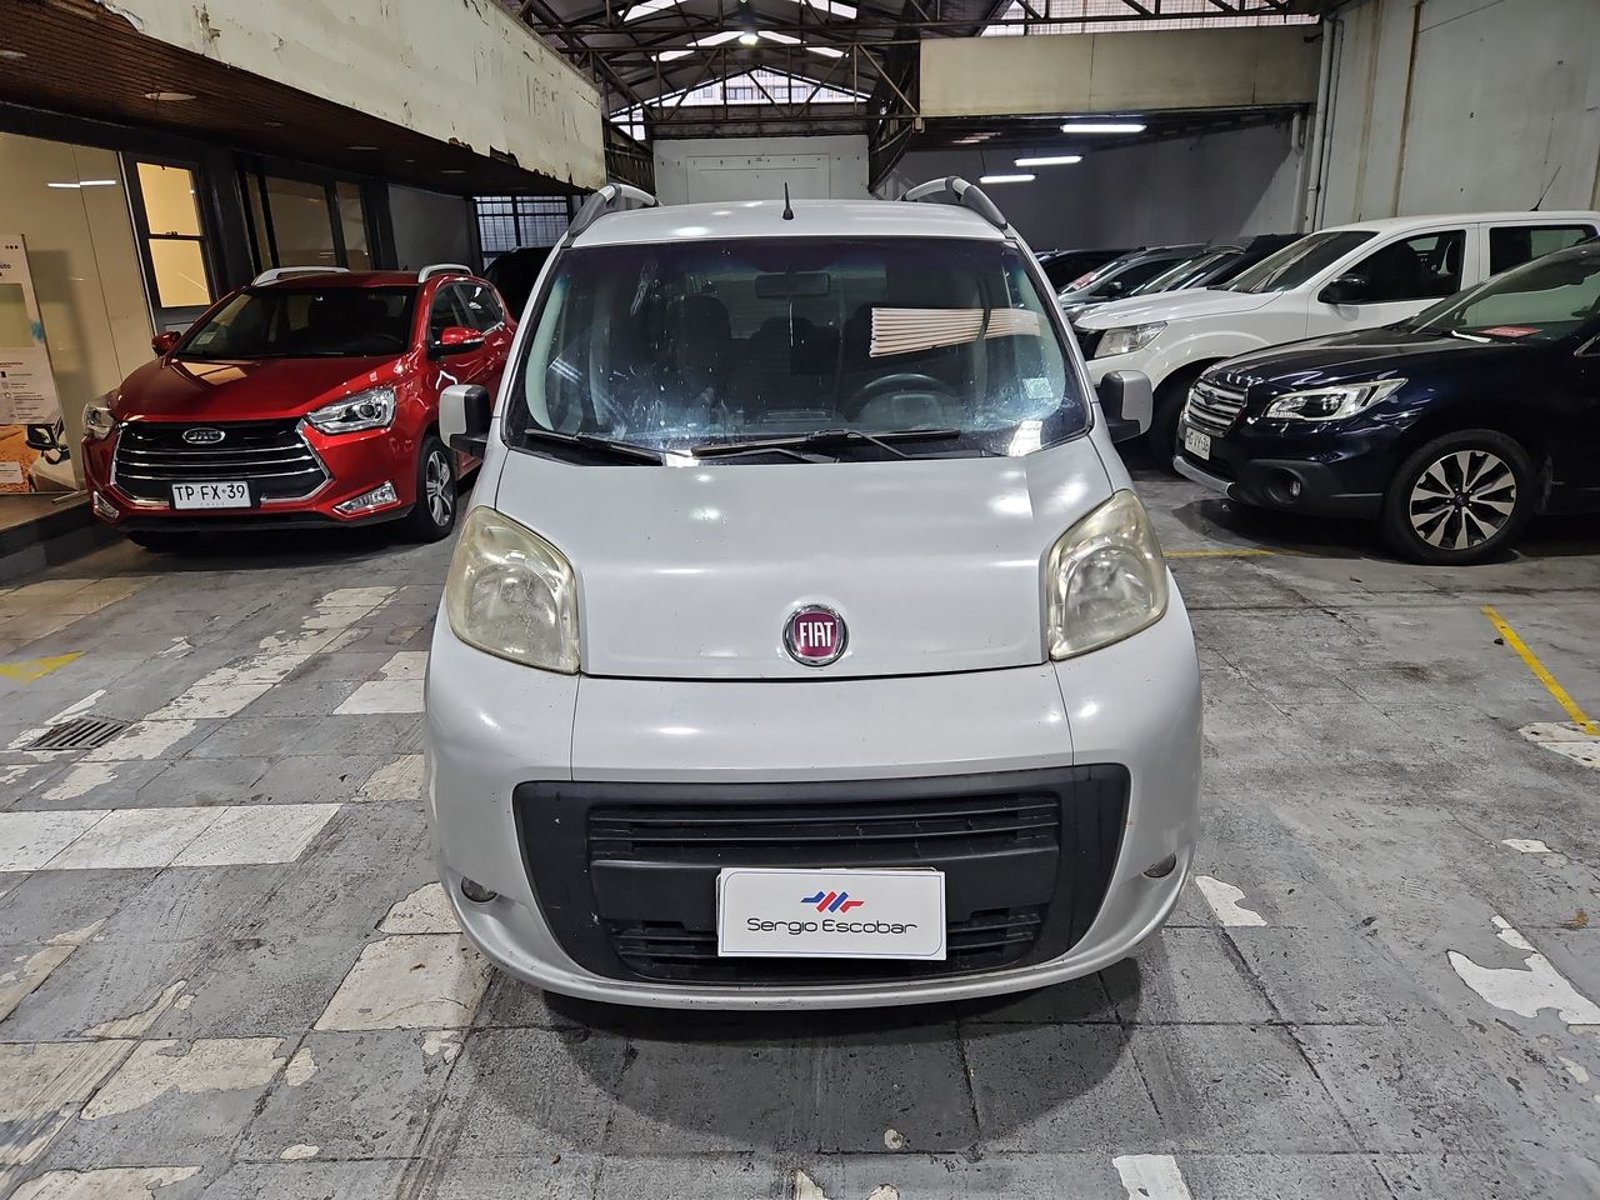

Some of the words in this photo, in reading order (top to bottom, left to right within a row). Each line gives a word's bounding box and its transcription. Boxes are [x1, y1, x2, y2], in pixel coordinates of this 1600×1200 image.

[800, 622, 834, 647] FIAT
[747, 918, 818, 935] Sergio
[822, 919, 918, 935] Escobar
